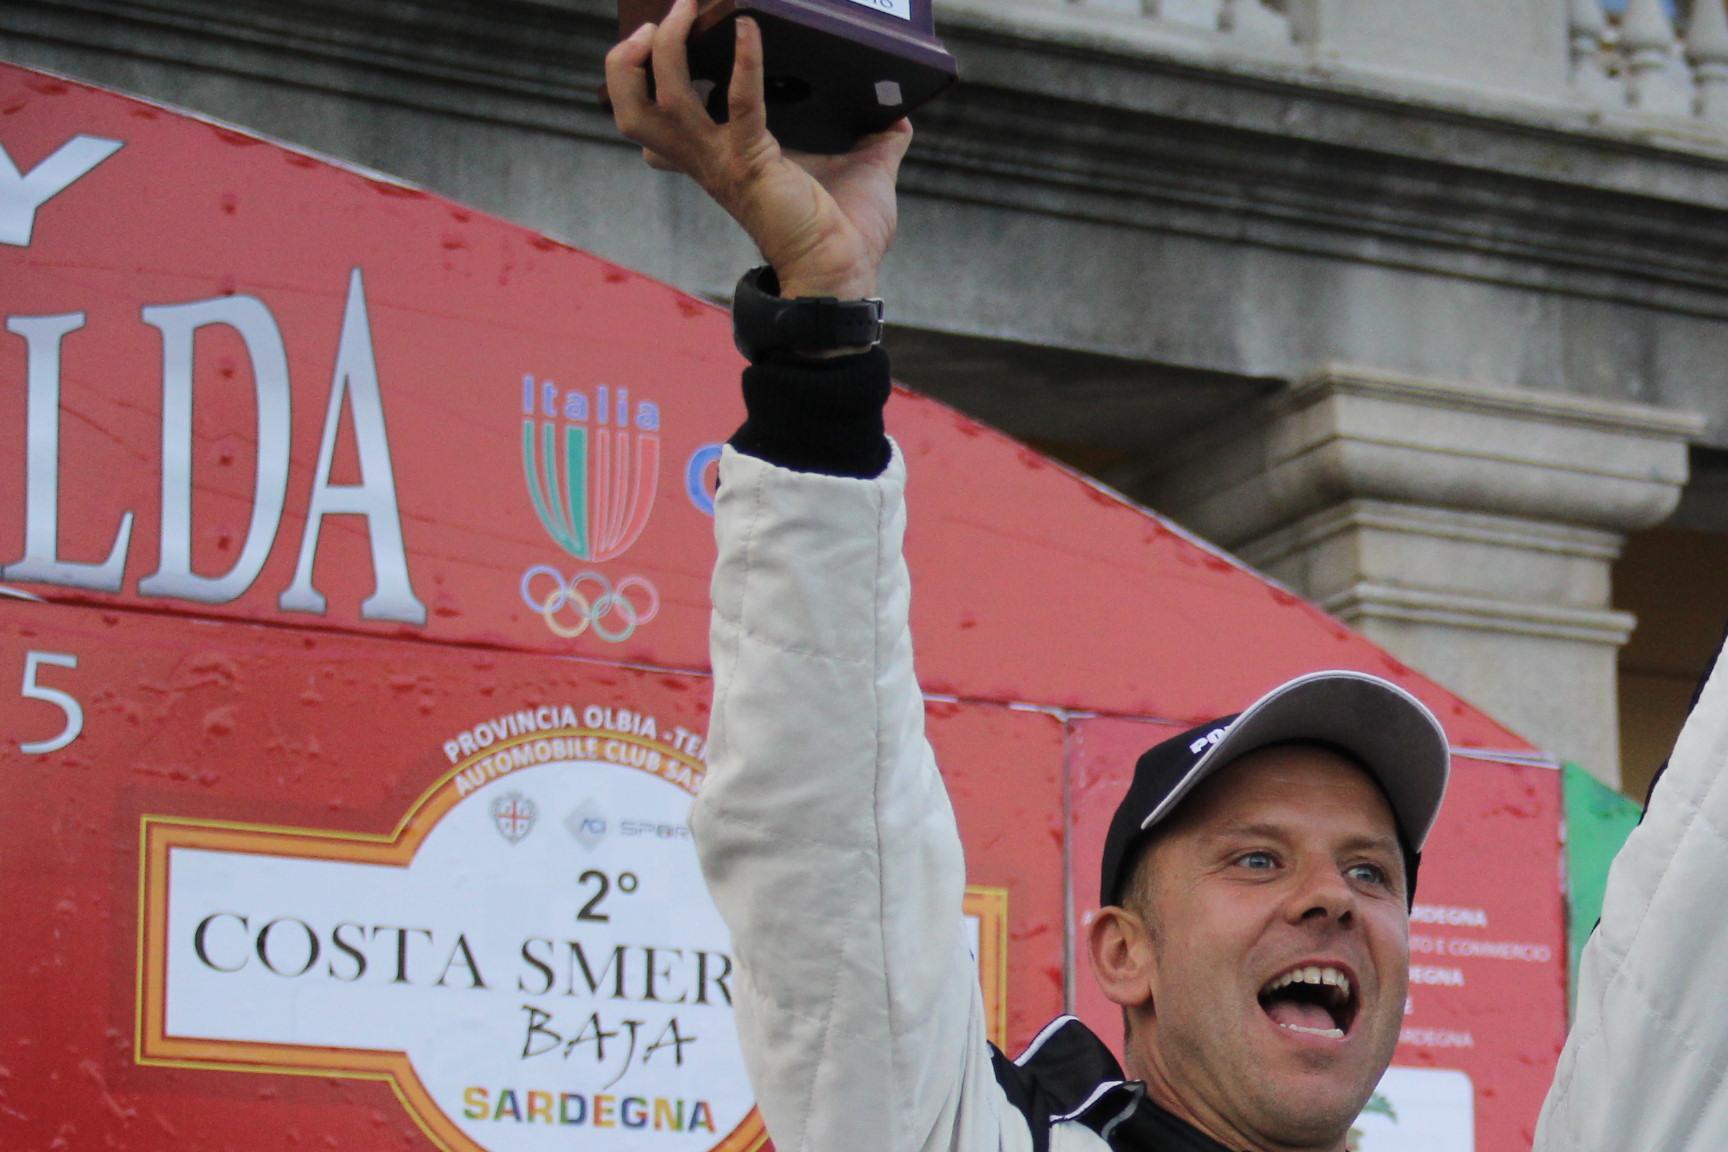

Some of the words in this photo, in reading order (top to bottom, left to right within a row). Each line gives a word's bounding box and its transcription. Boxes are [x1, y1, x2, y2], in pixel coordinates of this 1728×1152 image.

[522, 373, 661, 433] Italia
[0, 266, 428, 626] LDA
[20, 650, 84, 755] 5
[443, 705, 579, 765] PROVINCIA
[584, 704, 658, 740] OLBIA
[453, 737, 599, 797] AUTOMOBILE
[604, 740, 662, 772] CLUB
[193, 911, 490, 989] COSTA
[517, 936, 734, 1007] SMER
[1449, 938, 1551, 962] COMMERCIO
[521, 1003, 699, 1090] BAJA
[463, 1086, 717, 1134] SARDEGNA
